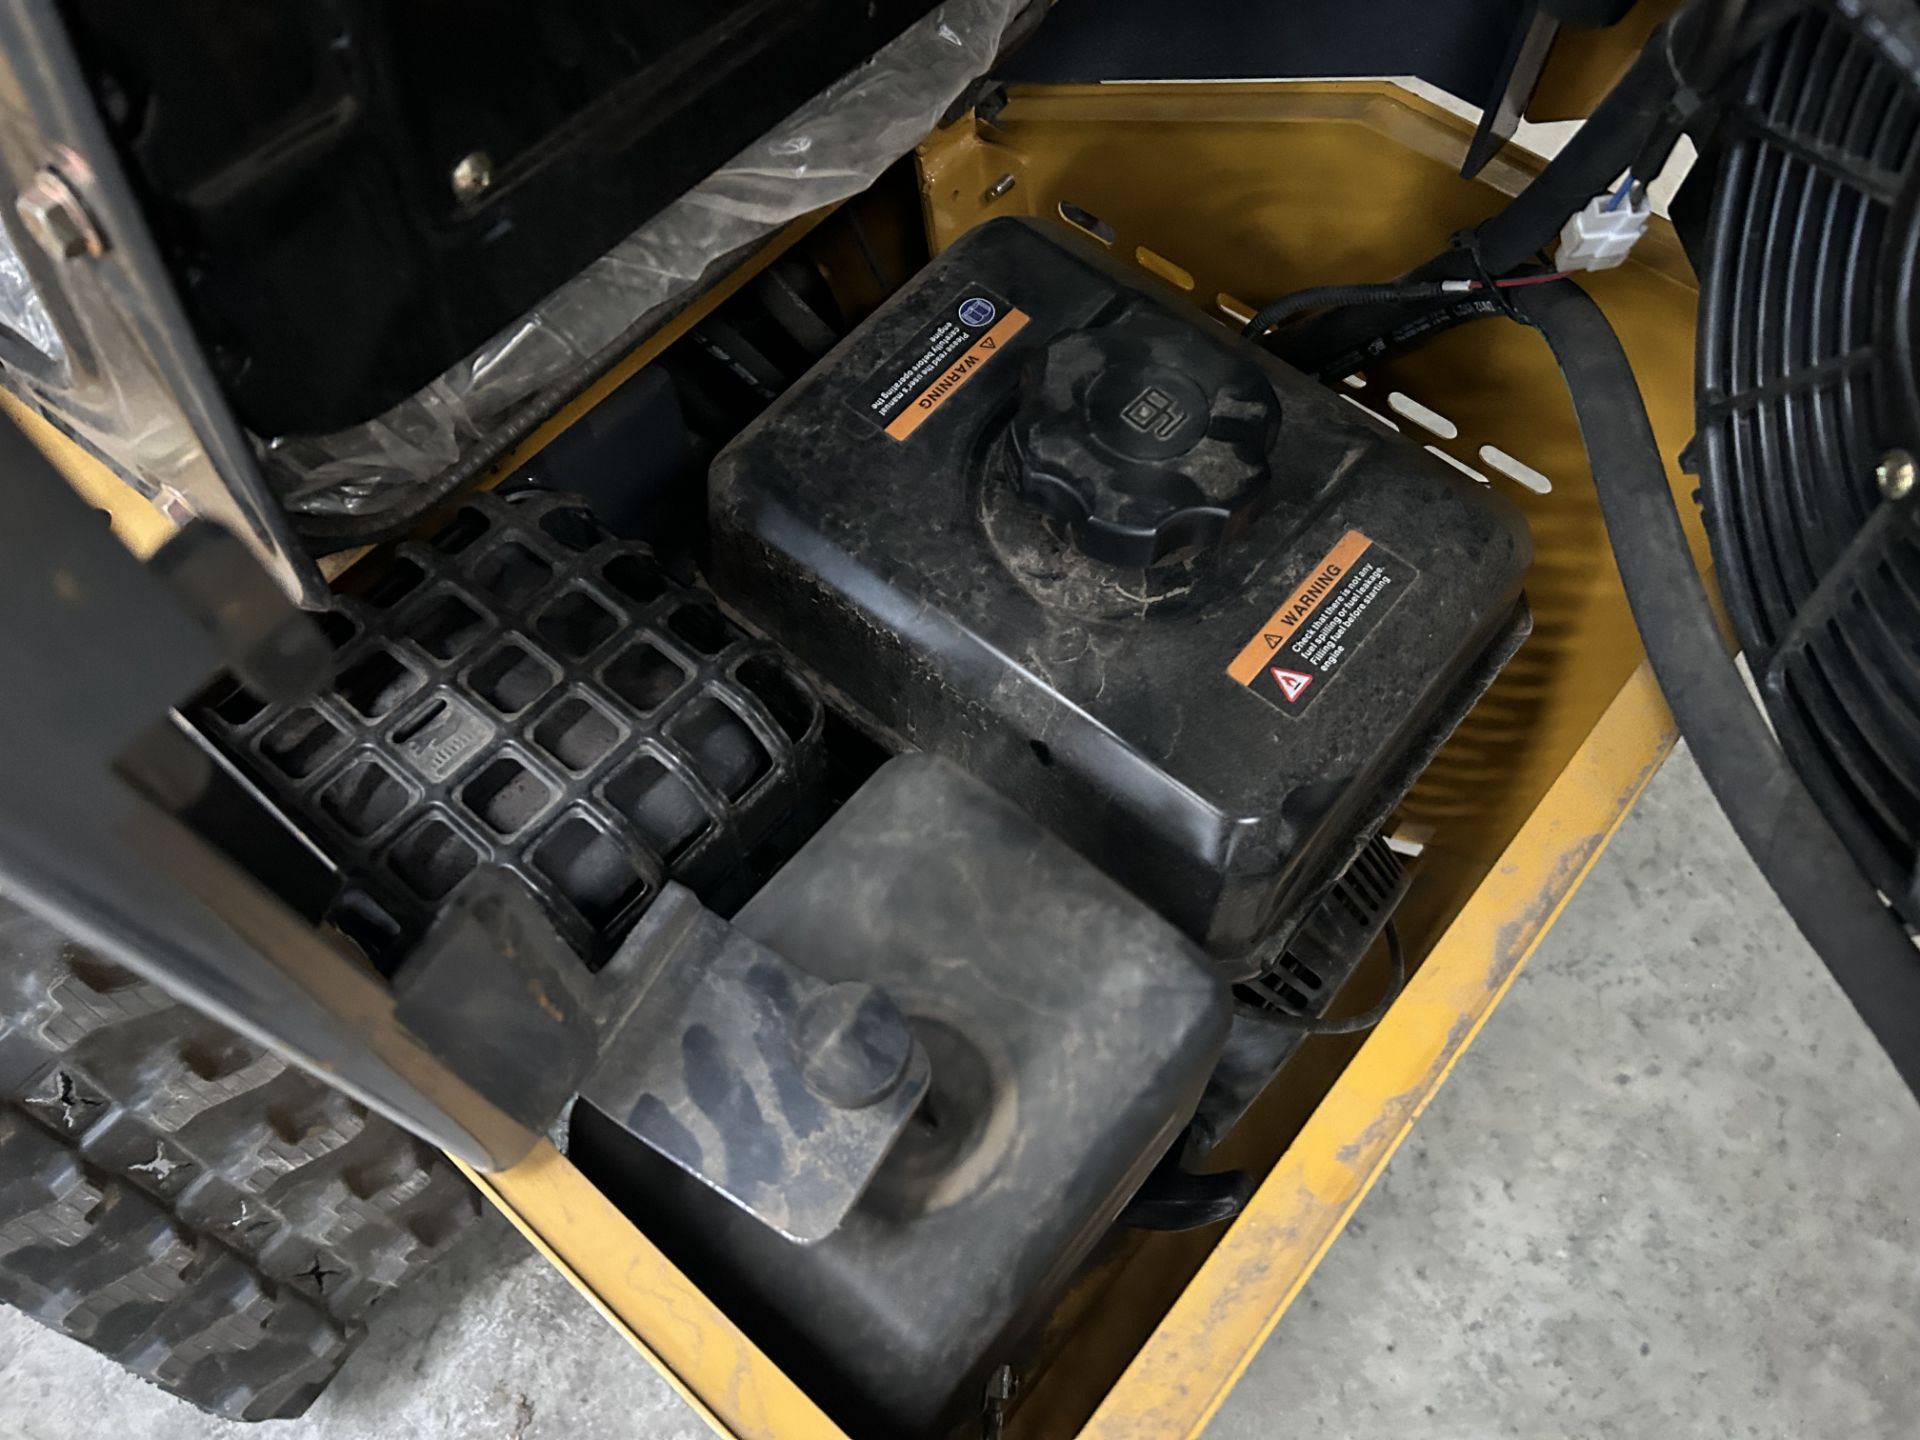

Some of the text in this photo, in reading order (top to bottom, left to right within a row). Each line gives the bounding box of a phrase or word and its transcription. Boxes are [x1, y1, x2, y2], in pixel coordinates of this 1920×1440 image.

[871, 327, 960, 409] carefully before operating the
[929, 322, 952, 342] engine
[878, 332, 970, 416] Please read the user's manual
[918, 355, 980, 409] WARNING
[1280, 564, 1342, 626] WARNING
[1292, 563, 1373, 653] Check that there is not any
[1301, 567, 1385, 659] fuel spilling or fuel leakage.
[1309, 576, 1391, 665] Filling fuel before starting
[1320, 645, 1345, 672] engine
